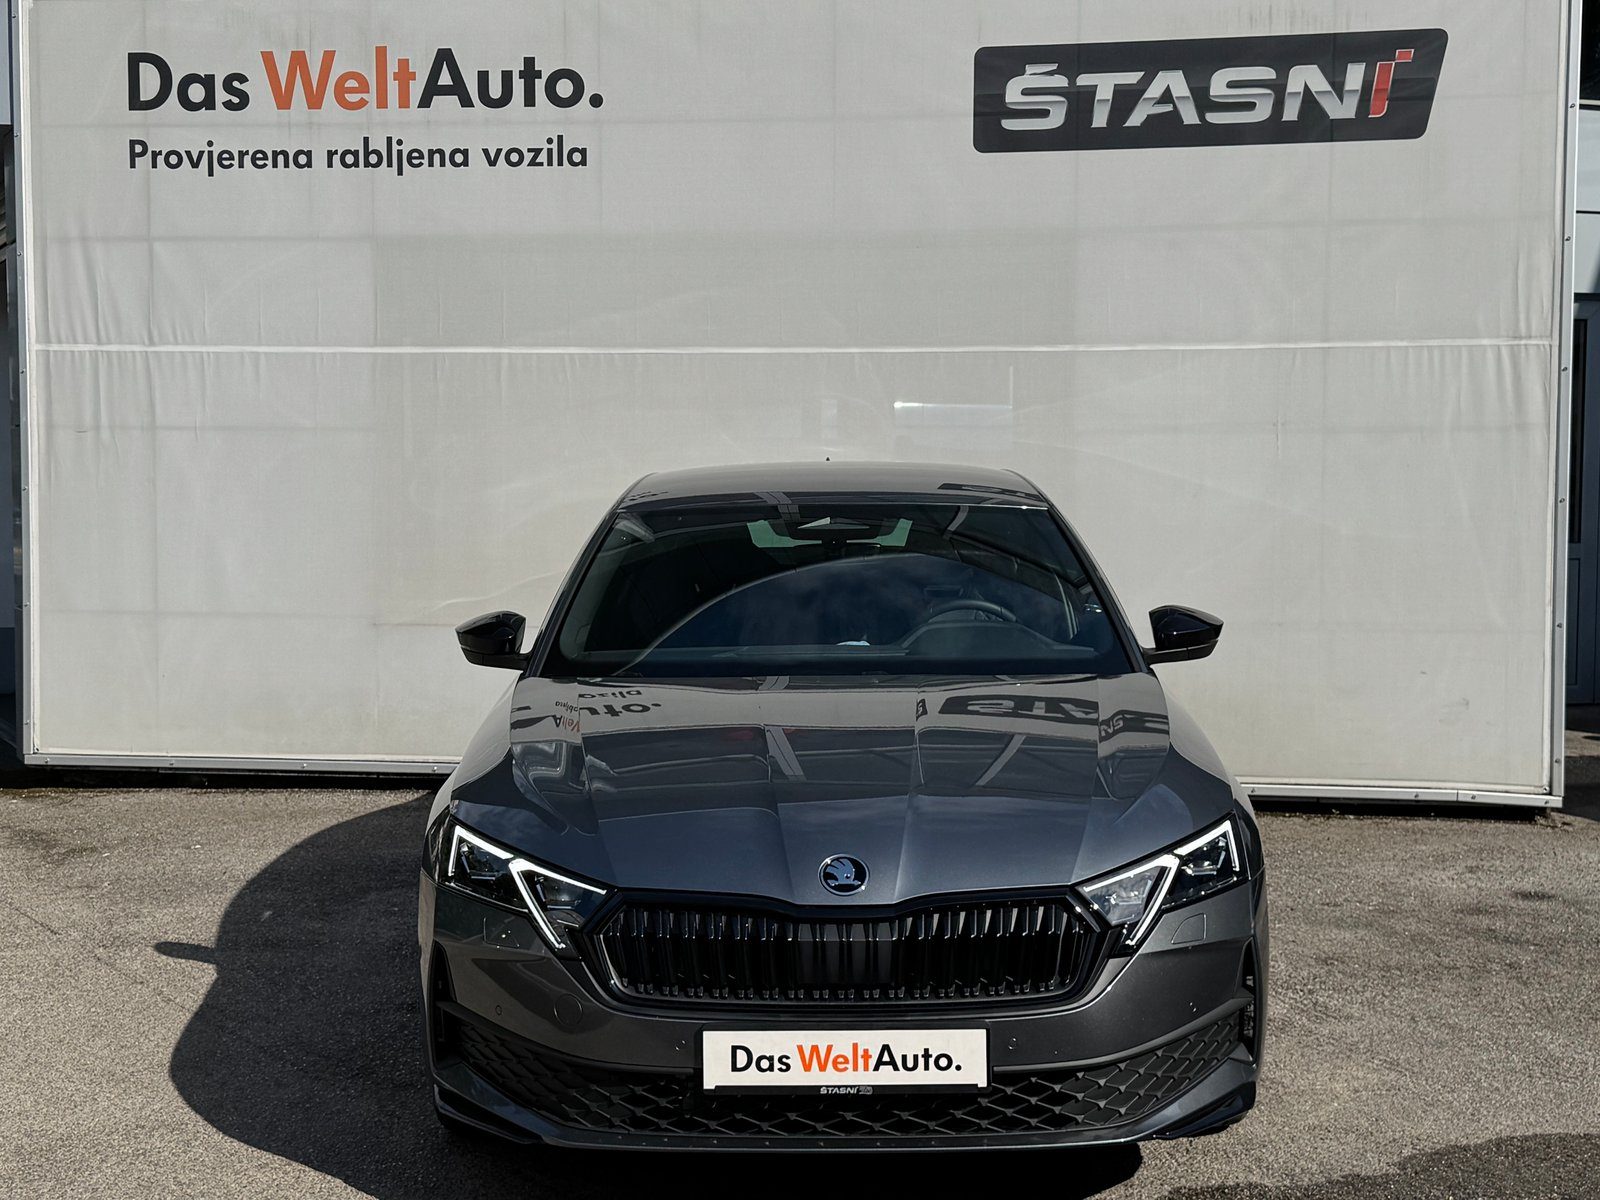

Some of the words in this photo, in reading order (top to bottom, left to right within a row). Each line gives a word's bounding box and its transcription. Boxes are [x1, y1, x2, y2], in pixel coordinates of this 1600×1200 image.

[127, 51, 249, 112] Das
[260, 46, 604, 111] WeltAuto.
[128, 138, 313, 177] Provjerena
[326, 136, 470, 177] rabljena
[482, 134, 588, 168] vozila
[730, 1044, 792, 1073] Das
[796, 1043, 962, 1073] WeltAuto.
